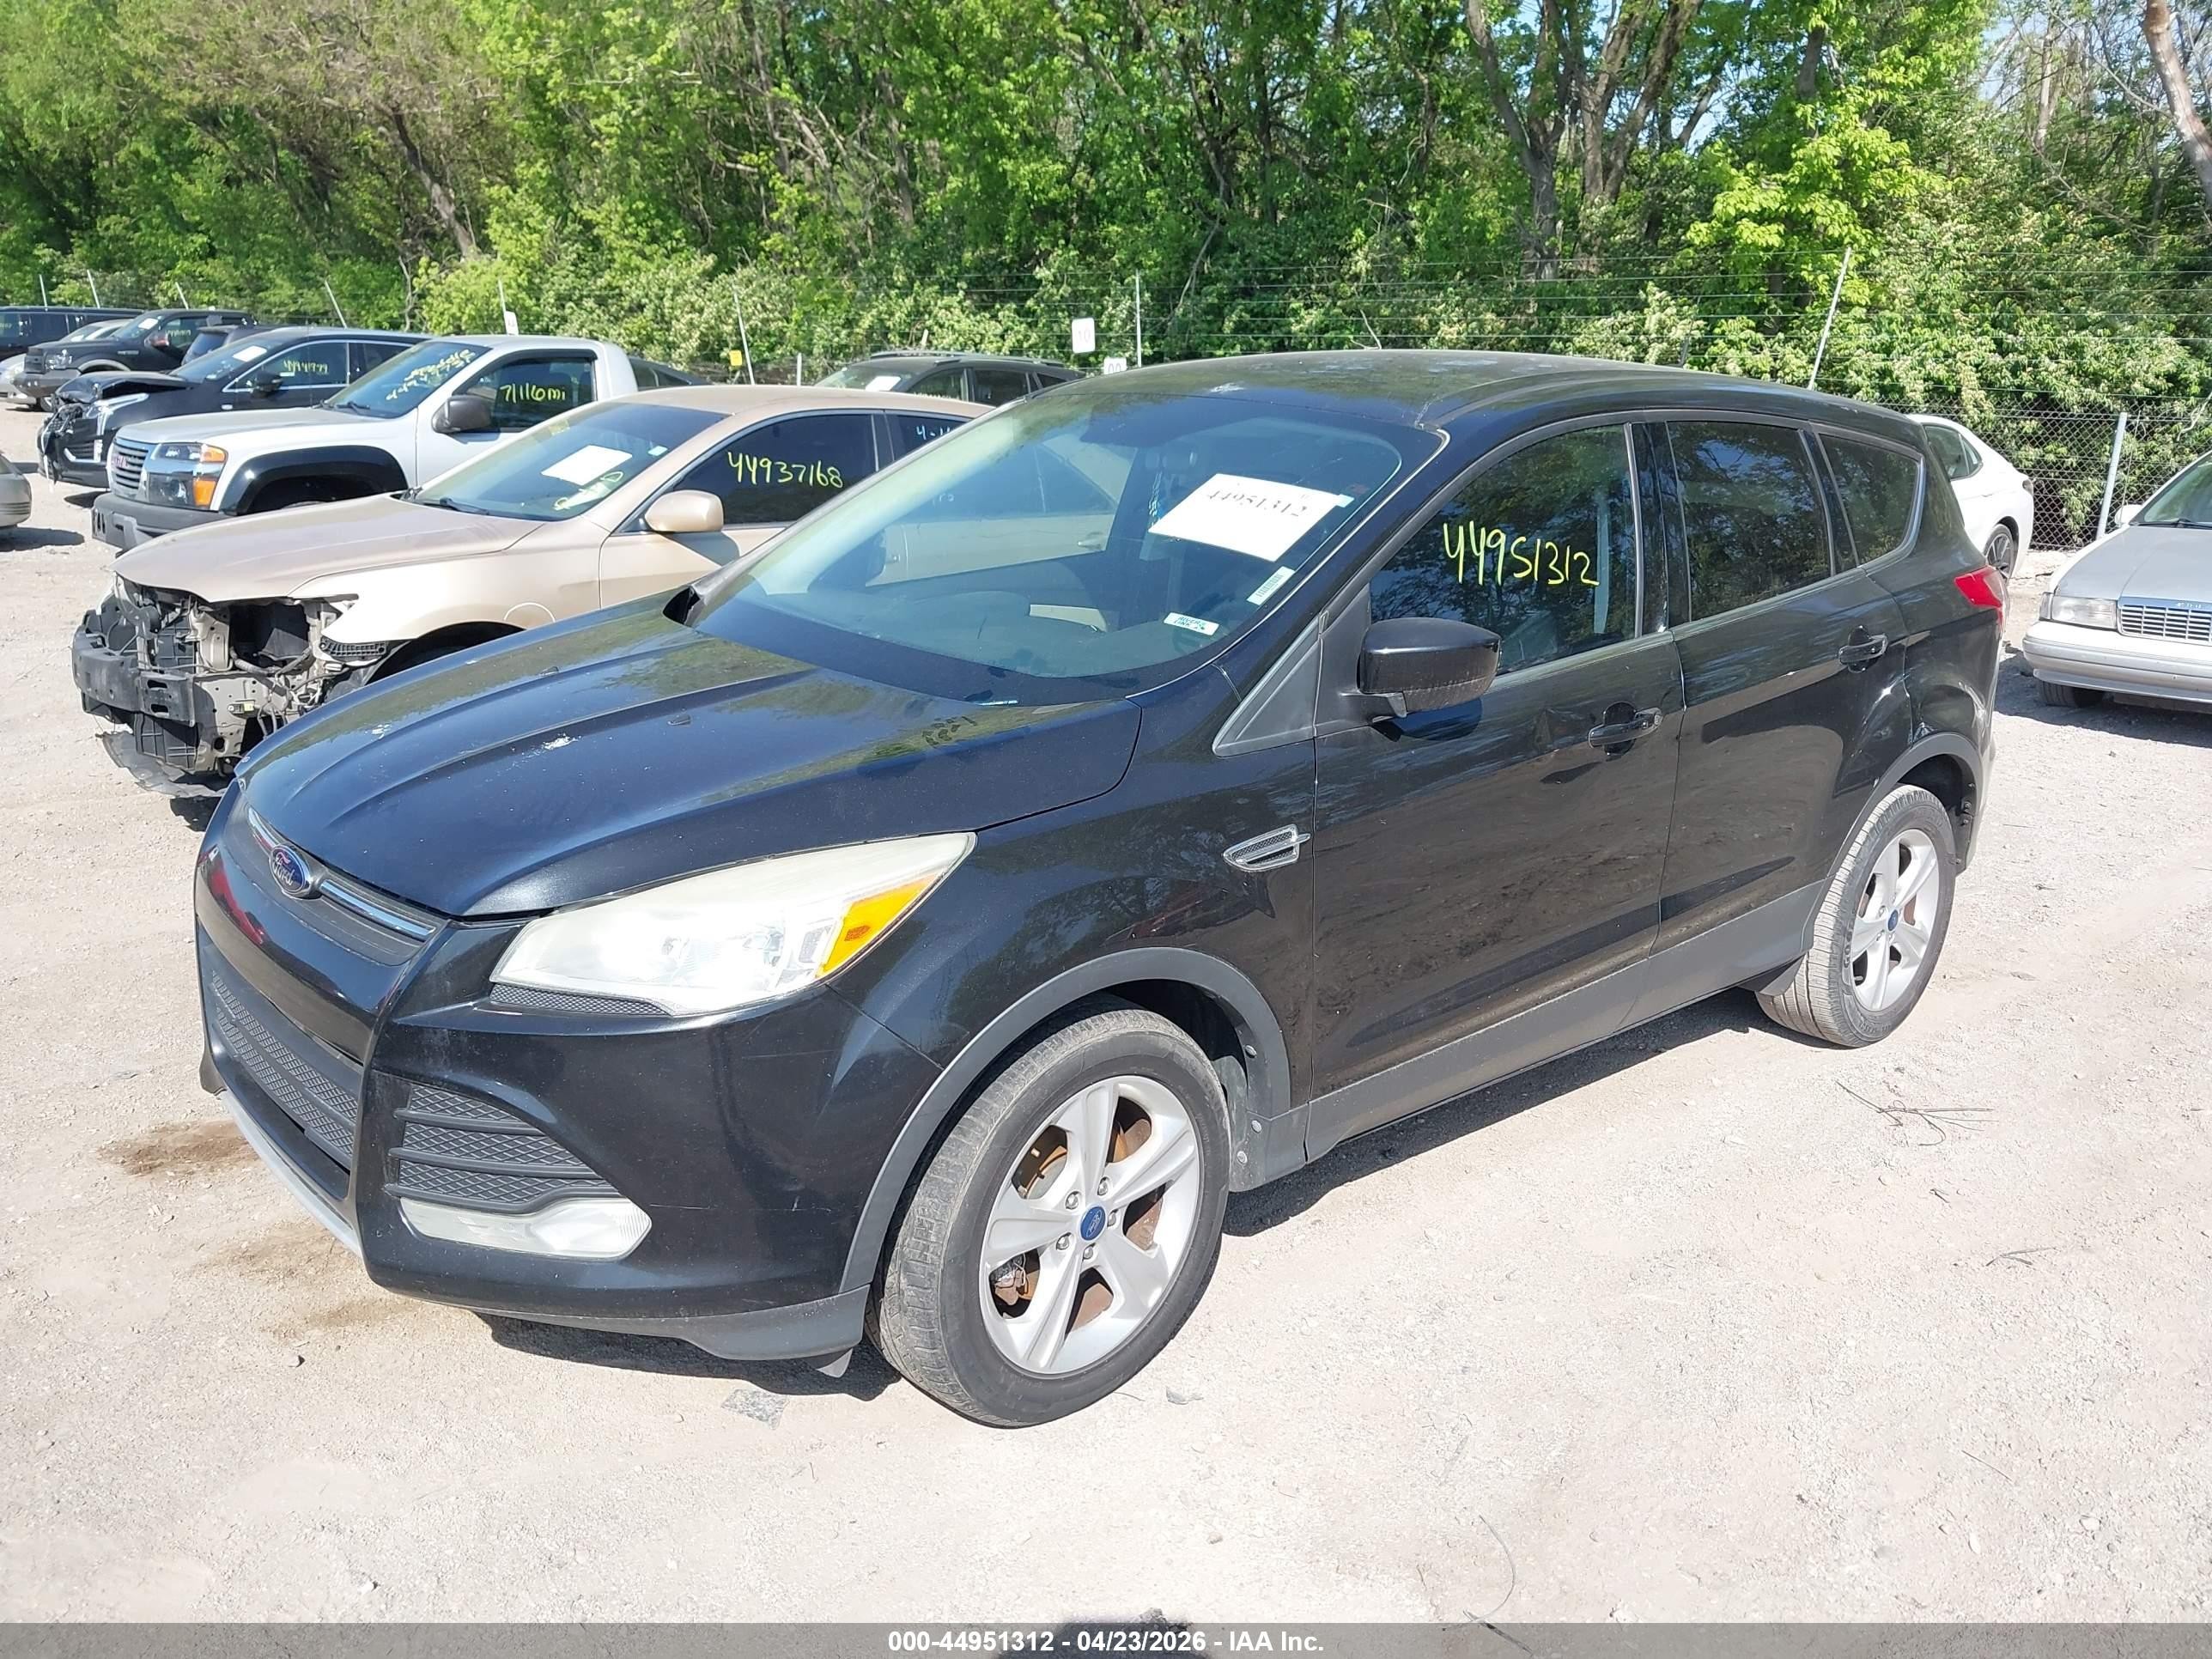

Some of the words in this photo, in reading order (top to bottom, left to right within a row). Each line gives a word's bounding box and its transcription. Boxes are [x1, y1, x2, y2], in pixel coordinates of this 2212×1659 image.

[727, 451, 844, 489] 44937168
[1443, 520, 1601, 586] 44951312
[273, 851, 295, 886] Ford
